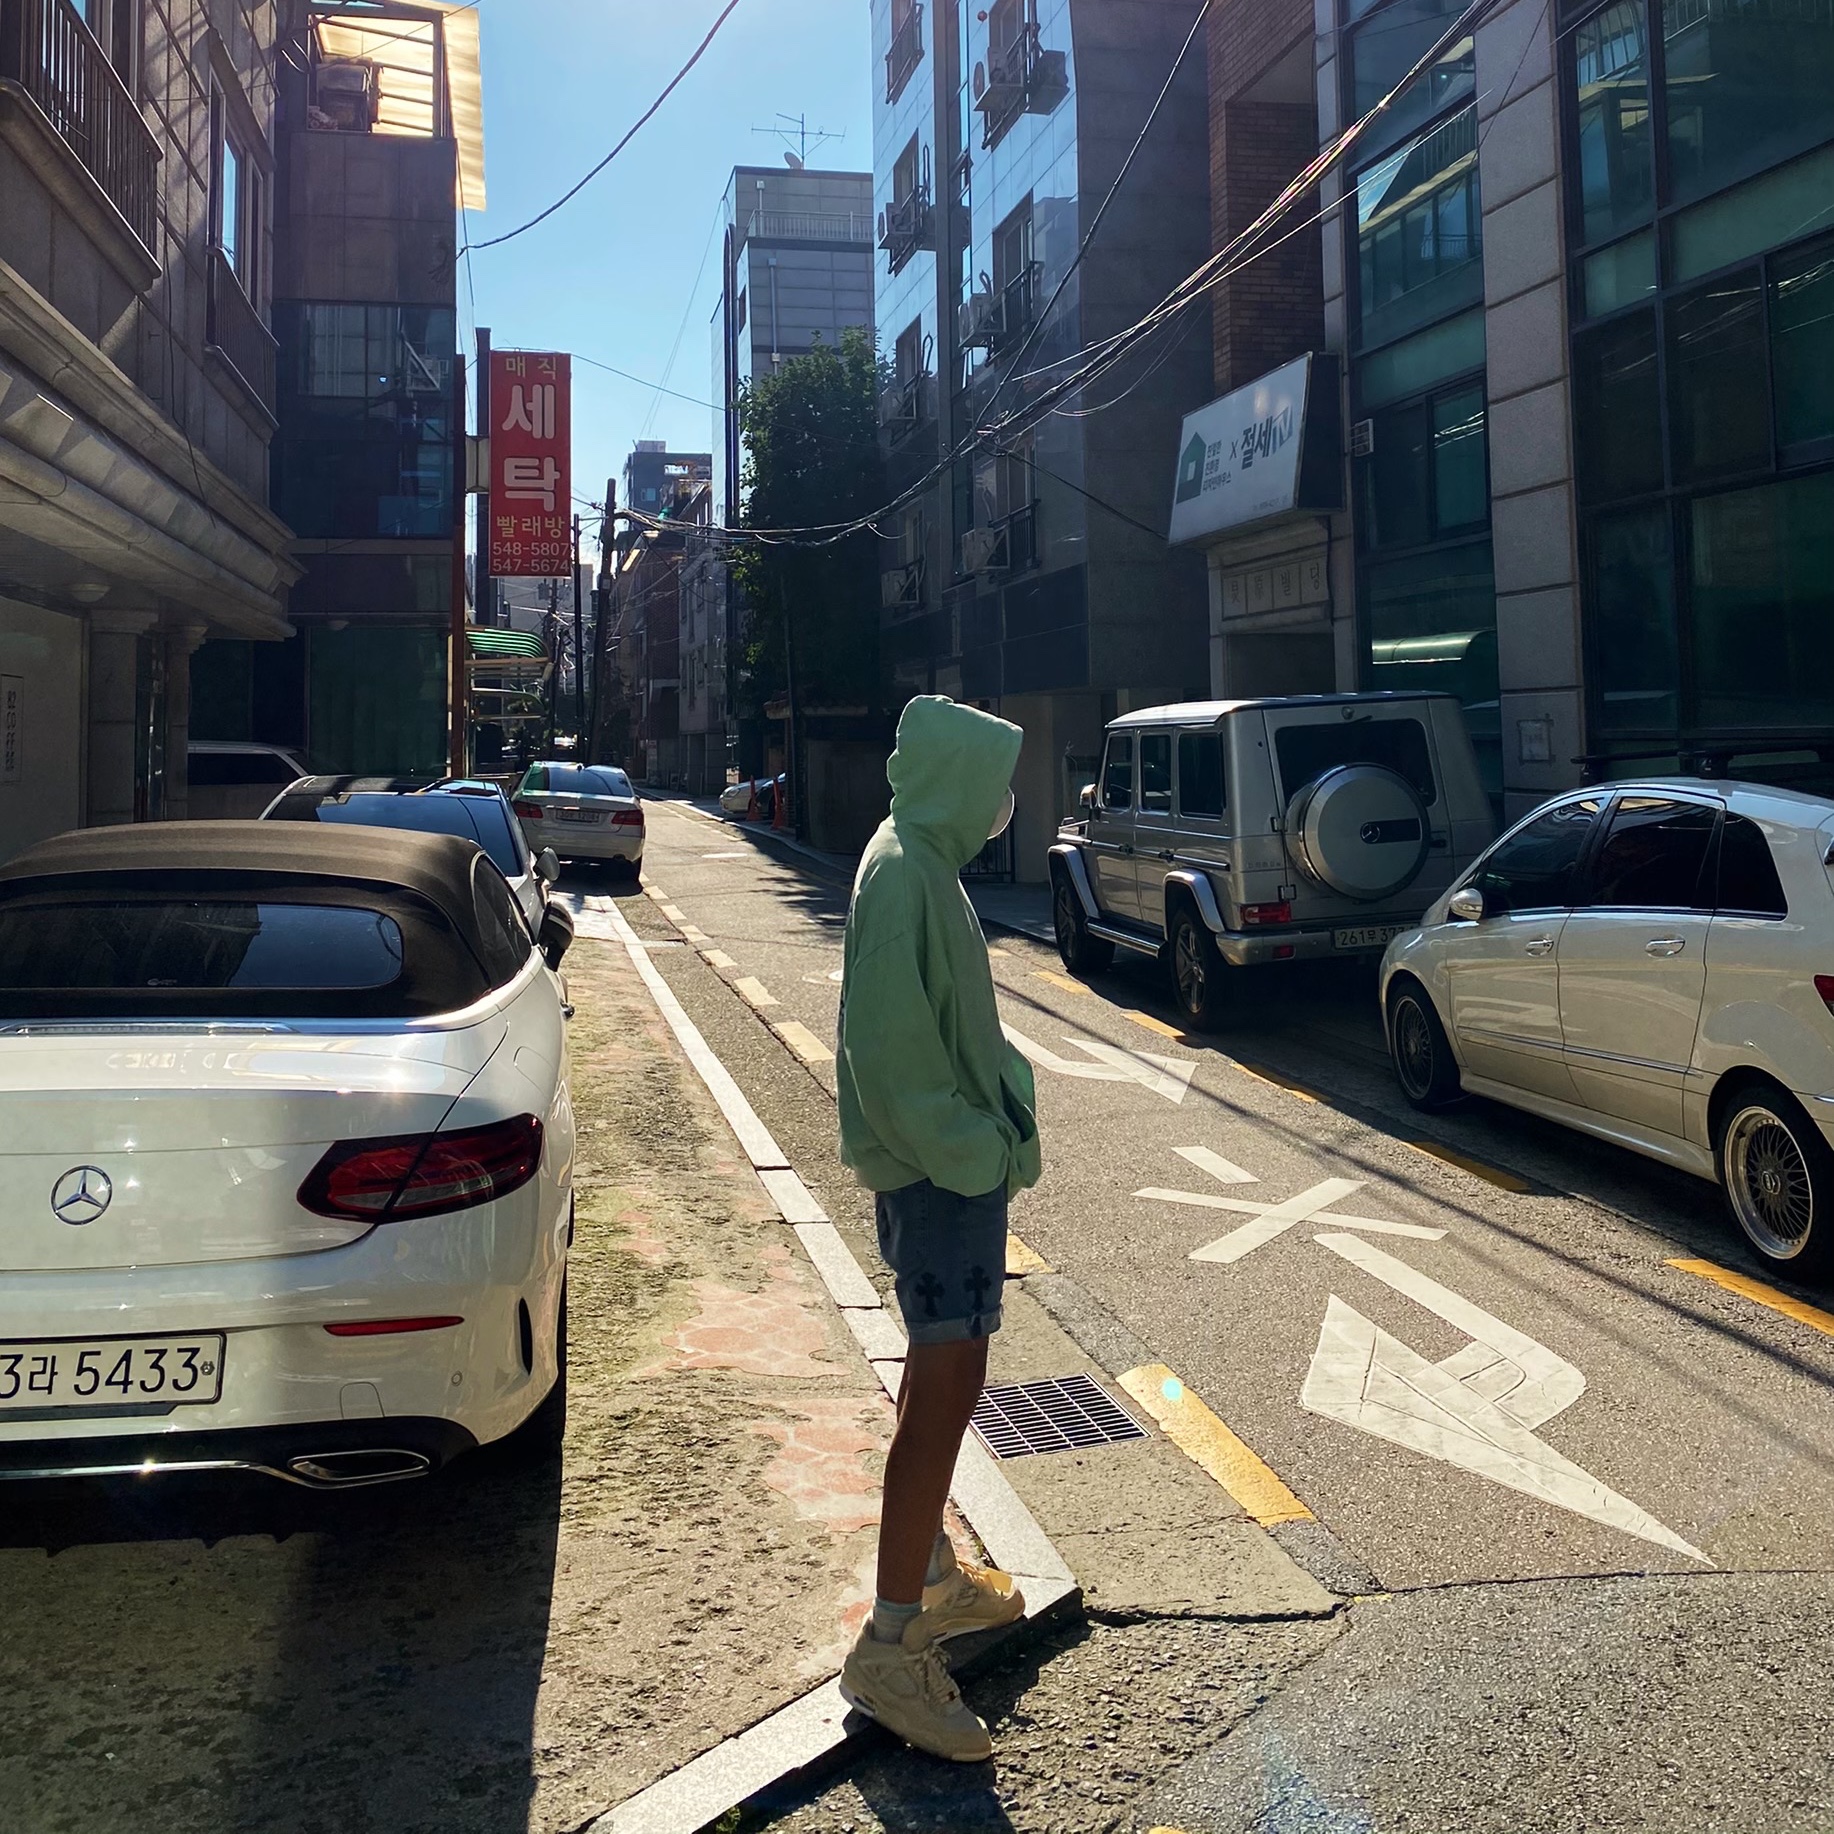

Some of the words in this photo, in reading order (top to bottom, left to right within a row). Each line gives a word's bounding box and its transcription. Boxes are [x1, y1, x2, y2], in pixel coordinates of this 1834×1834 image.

[505, 356, 557, 381] 매직
[502, 383, 561, 512] 세탁
[496, 515, 565, 539] 빨래방
[492, 541, 569, 557] 548-5807
[492, 558, 570, 573] 547-5674
[73, 1346, 201, 1397] 5433
